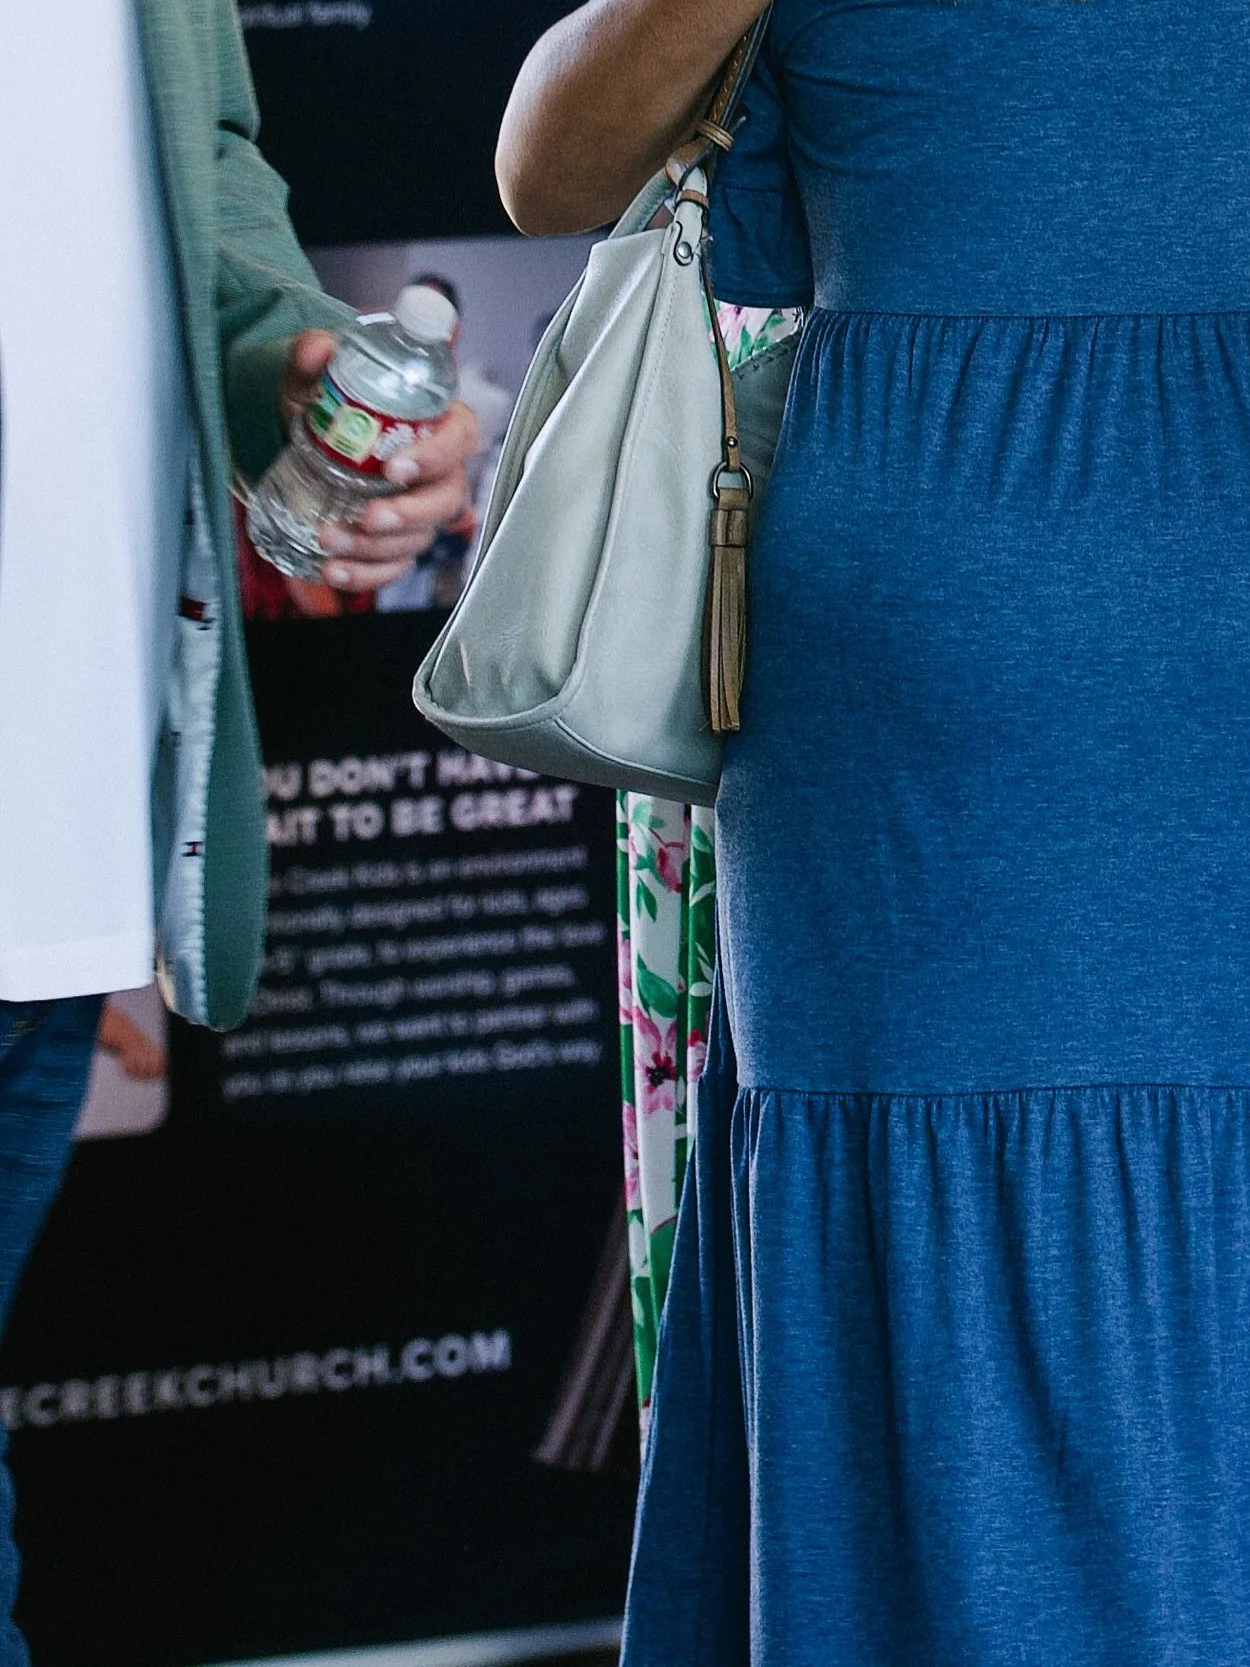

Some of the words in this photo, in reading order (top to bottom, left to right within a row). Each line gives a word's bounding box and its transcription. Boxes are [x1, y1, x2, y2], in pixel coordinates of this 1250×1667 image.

[309, 750, 429, 798] DON'T
[267, 807, 319, 848] AIT
[331, 801, 384, 843] TO
[390, 795, 444, 836] BE
[450, 783, 579, 833] GREAT
